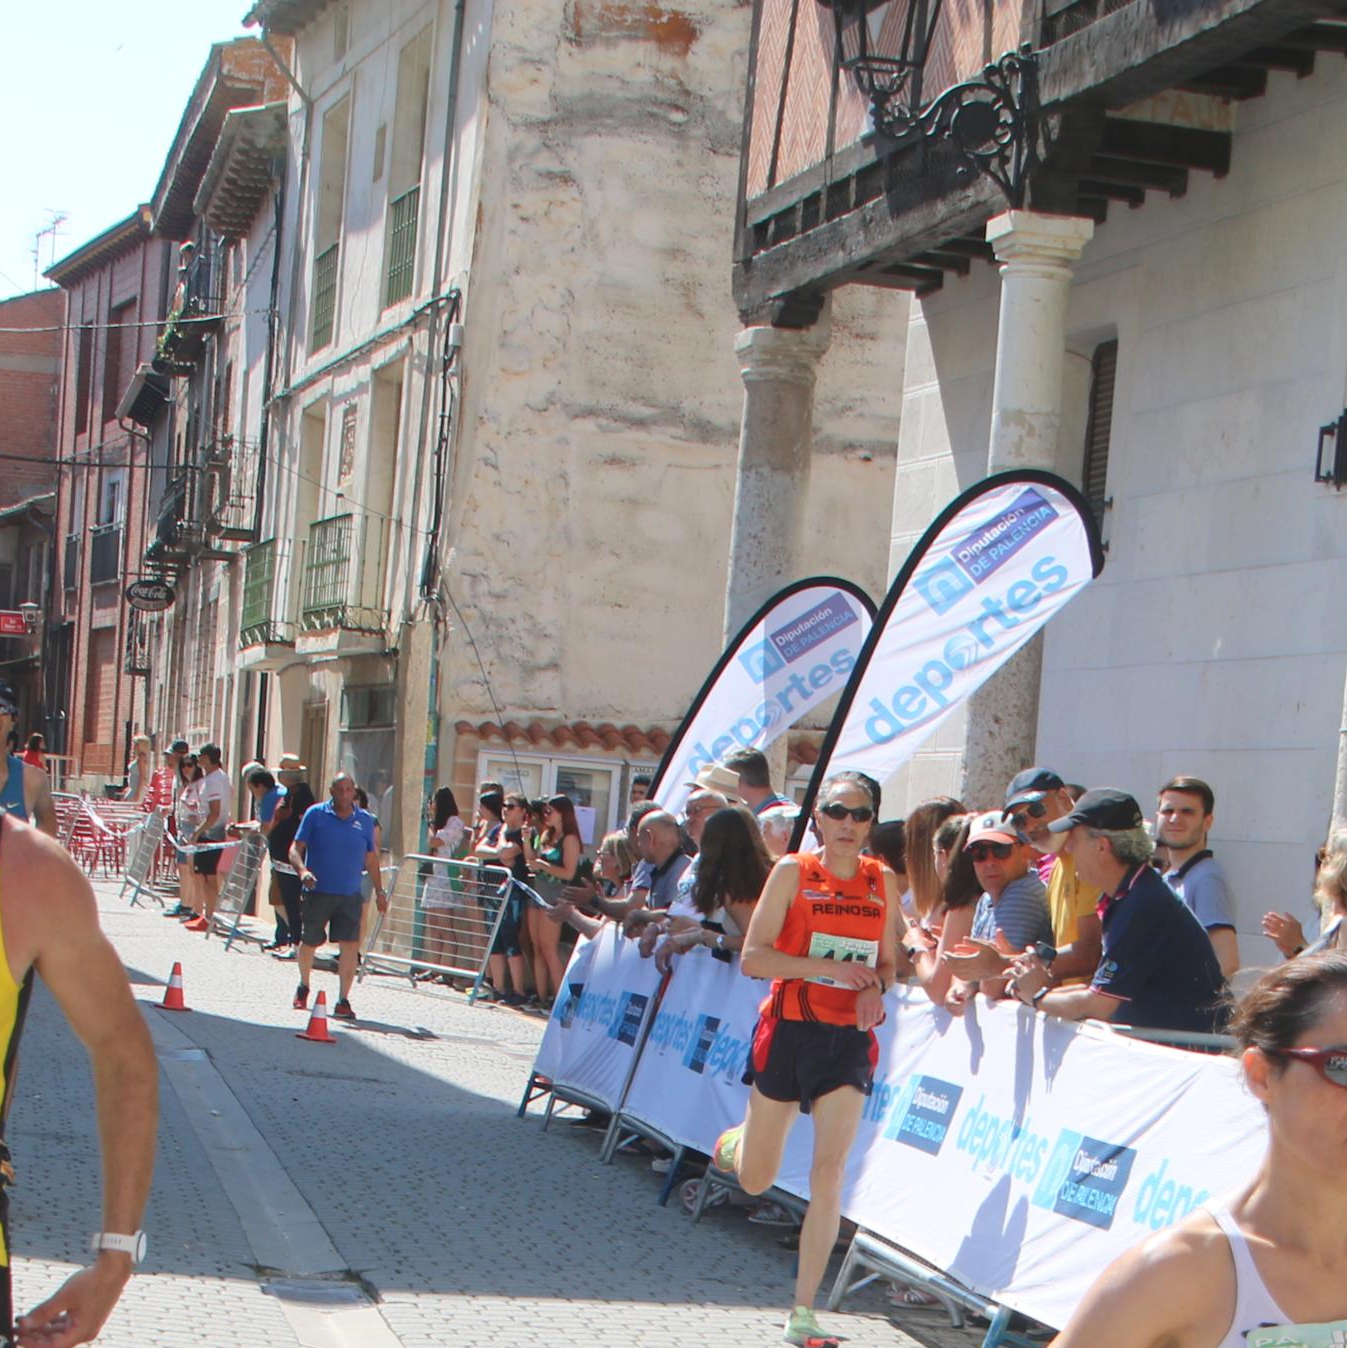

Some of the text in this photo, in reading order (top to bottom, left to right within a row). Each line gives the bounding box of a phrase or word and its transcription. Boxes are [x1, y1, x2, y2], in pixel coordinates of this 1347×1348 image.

[958, 507, 1026, 564] Diputación
[970, 506, 1052, 577] DE PALENCIA
[776, 607, 834, 646] Diputación
[783, 611, 853, 658] DE PALENCIA
[863, 555, 1069, 747] deportes
[812, 903, 881, 919] REINOSA
[911, 1086, 949, 1115] Diputación
[956, 1093, 1049, 1180] deportes
[1255, 1336, 1299, 1348] PA
